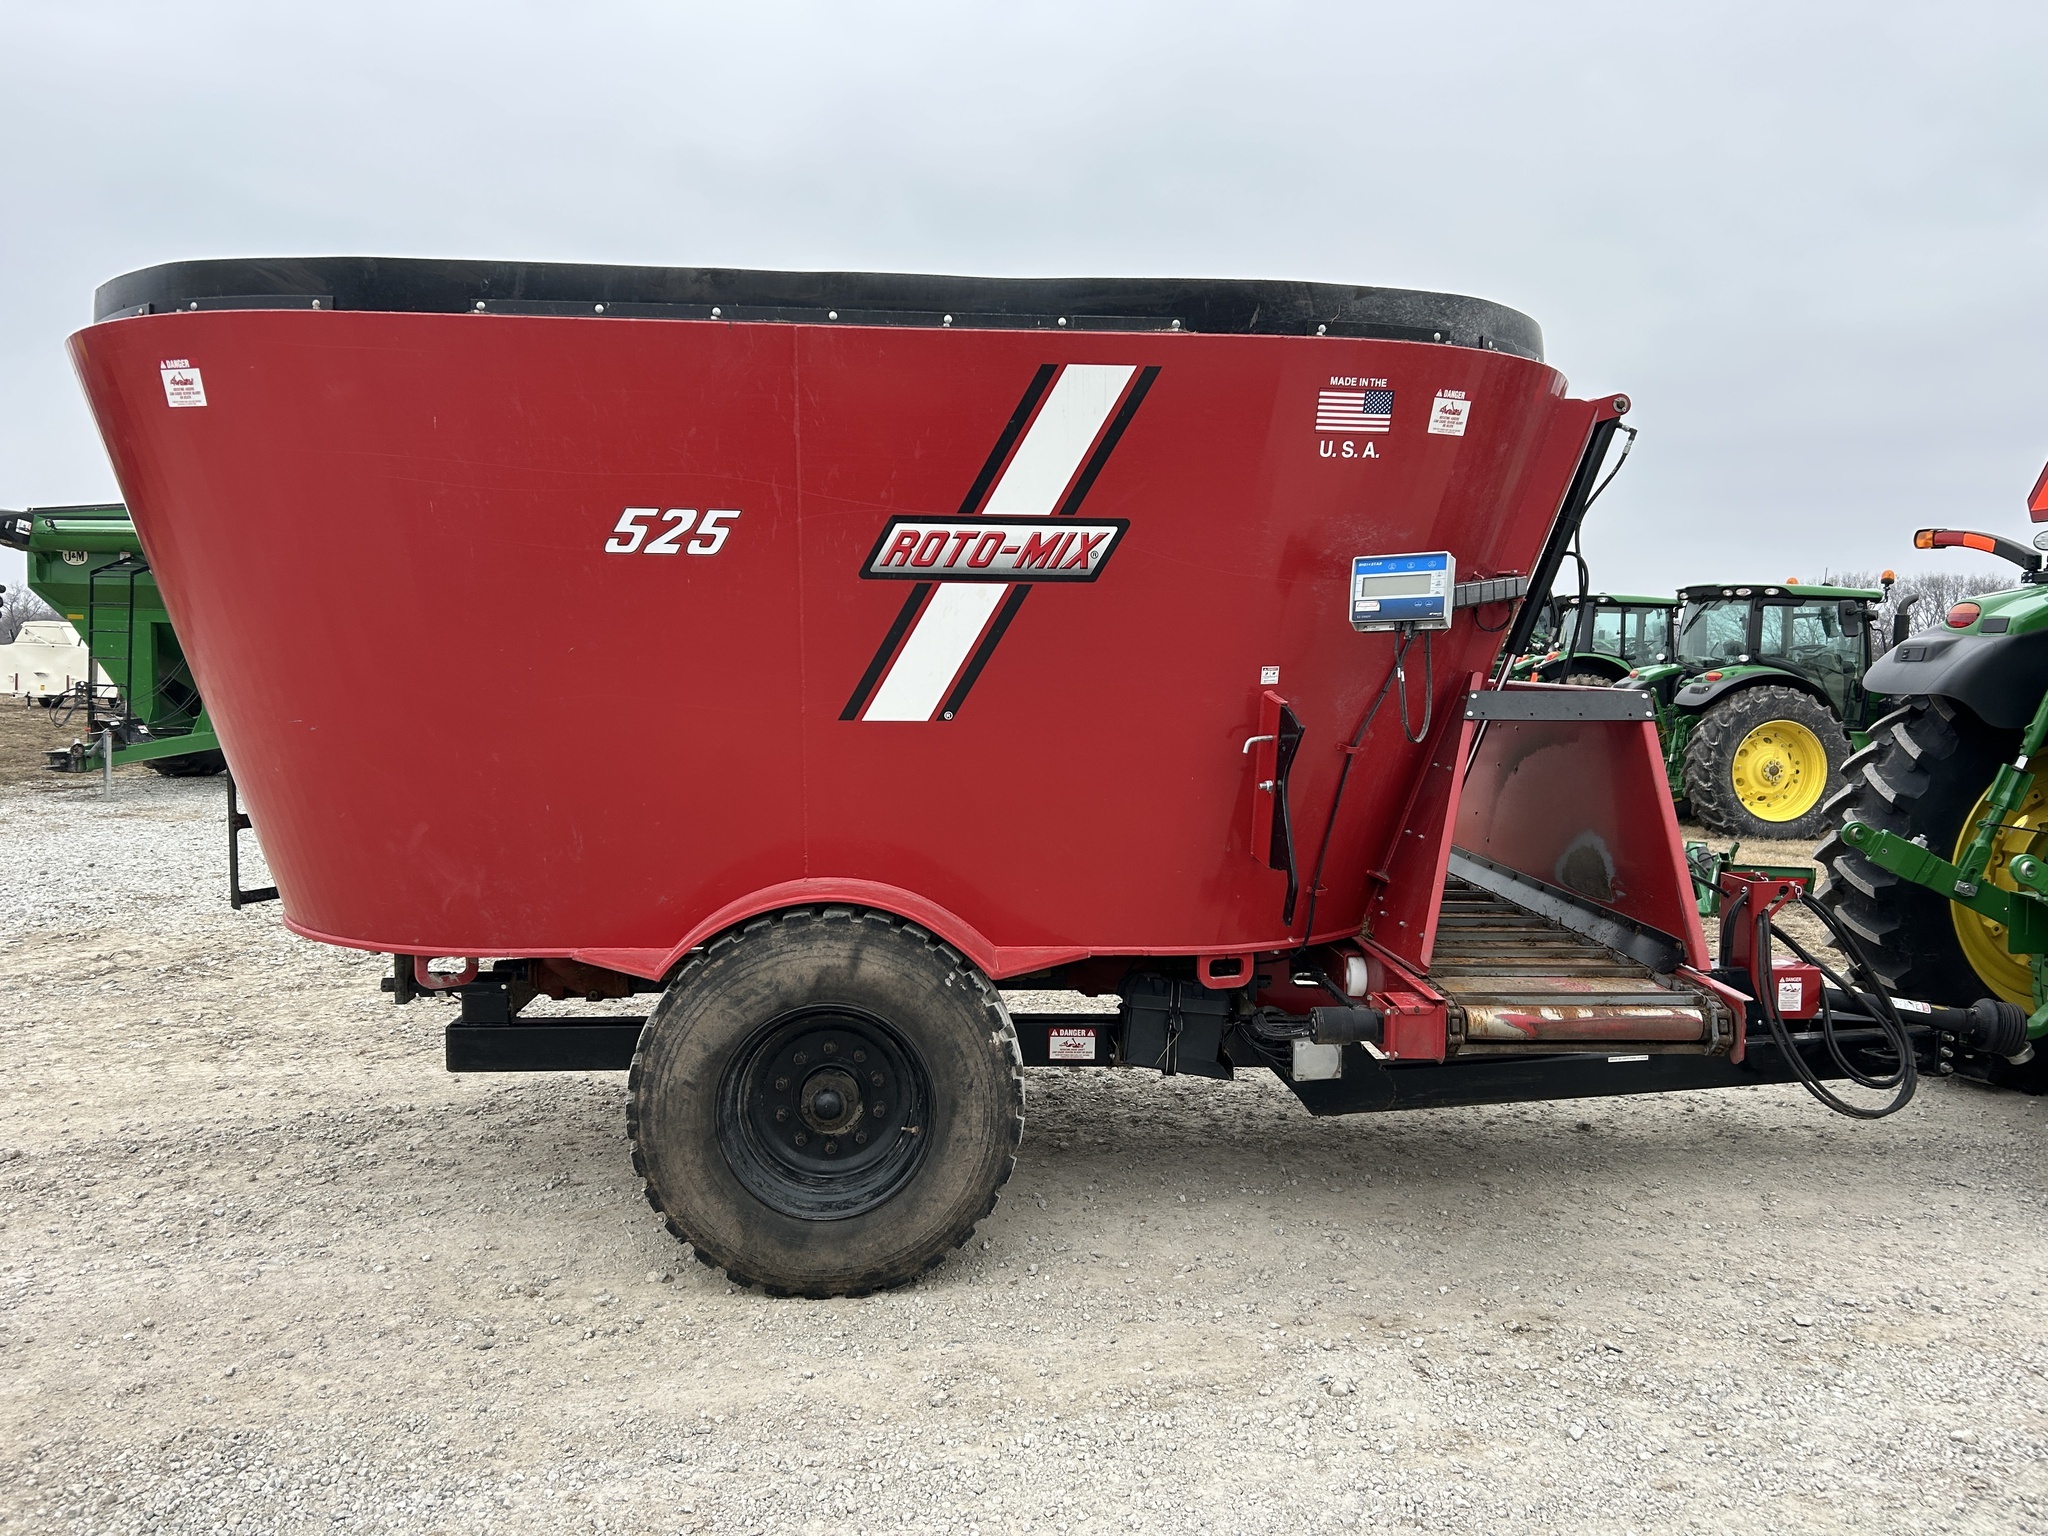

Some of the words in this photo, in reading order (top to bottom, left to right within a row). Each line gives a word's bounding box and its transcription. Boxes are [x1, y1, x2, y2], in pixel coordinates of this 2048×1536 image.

[165, 359, 190, 369] DANGER
[1330, 376, 1357, 387] MADE
[1359, 377, 1370, 387] IN
[1370, 378, 1388, 388] THE
[1443, 389, 1466, 399] DANGER
[604, 507, 743, 555] 525
[64, 551, 85, 562] J&M
[1059, 1029, 1086, 1037] DANGER
